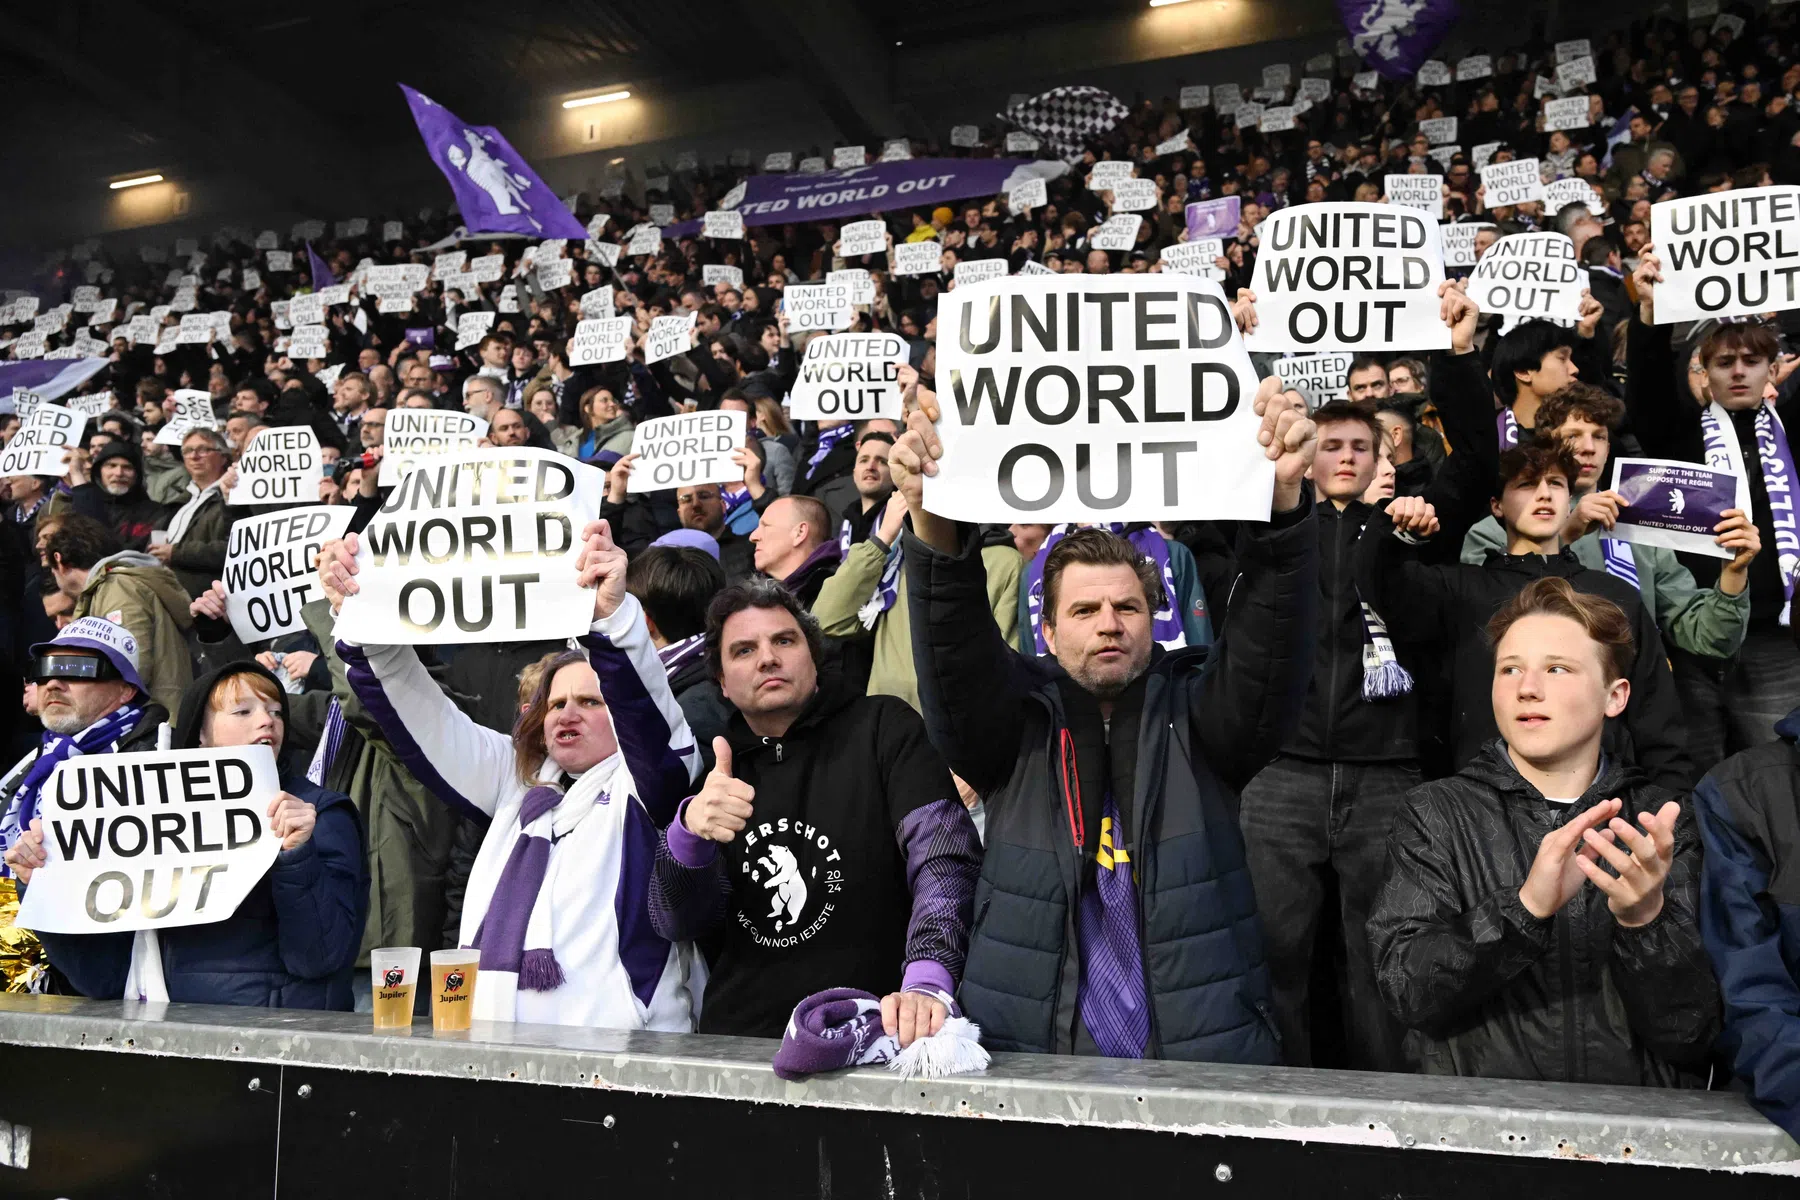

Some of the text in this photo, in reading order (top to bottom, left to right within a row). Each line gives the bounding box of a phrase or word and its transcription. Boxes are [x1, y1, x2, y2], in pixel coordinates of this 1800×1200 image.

[1550, 107, 1586, 118] WORLD
[1554, 117, 1579, 128] OUT
[1486, 162, 1534, 179] UNITED
[1391, 178, 1437, 188] UNITED
[1486, 173, 1537, 190] WORLD
[1549, 181, 1589, 191] UNITE
[738, 199, 790, 216] TED
[797, 184, 889, 210] WORLD
[896, 174, 955, 194] OUT
[1116, 189, 1155, 198] WORLD
[1391, 190, 1437, 201] WORLD
[1497, 187, 1531, 203] OUT
[1122, 200, 1148, 209] OUT
[1671, 193, 1800, 235] UNITE
[844, 223, 880, 234] UNITED
[1271, 212, 1427, 252] UNITED
[1446, 227, 1476, 237] UNIT
[843, 232, 881, 243] WORLD
[1101, 237, 1126, 247] OUT
[850, 242, 875, 253] OUT
[899, 244, 938, 253] UNITED
[1167, 242, 1216, 258] UNITED
[1486, 238, 1575, 260] UNITED
[1667, 229, 1800, 271] WORL
[899, 252, 938, 261] WORLD
[1168, 254, 1216, 269] WORLD
[1454, 251, 1476, 263] OU
[904, 262, 931, 272] OUT
[958, 262, 1002, 274] UNITED
[1264, 255, 1431, 293] WORLD
[1478, 260, 1578, 283] WORLD
[543, 278, 563, 287] OUT
[831, 272, 871, 281] UNITED
[791, 286, 846, 298] UNITED
[1695, 266, 1800, 311] OUT
[325, 293, 341, 302] OUT
[790, 298, 846, 312] WORLD
[1487, 286, 1560, 312] OUT
[296, 313, 315, 323] OUT
[799, 312, 838, 327] OUT
[959, 291, 1233, 355] UNITED
[1288, 301, 1406, 344] OUT
[578, 320, 624, 334] UNITED
[461, 332, 480, 345] OUT
[576, 332, 624, 346] WORLD
[582, 347, 614, 361] OUT
[655, 338, 679, 357] OUT
[809, 339, 901, 360] UNITED
[804, 361, 899, 383] WORLD
[1279, 358, 1346, 377] UNITED
[1285, 375, 1347, 391] ORLD
[818, 389, 886, 414] OUT
[949, 362, 1240, 425] WORLD
[79, 403, 102, 414] OUT
[32, 410, 72, 429] TED
[391, 415, 475, 434] UNITED
[644, 415, 733, 440] UNITED
[9, 430, 68, 449] ORLD
[245, 431, 311, 453] UNITED
[388, 436, 472, 455] WORLD
[640, 435, 733, 460] WORLD
[3, 451, 48, 472] OUT
[240, 453, 312, 474] WORLD
[653, 458, 717, 484] OUT
[997, 441, 1197, 512] OUT
[1648, 467, 1713, 480] SUPPORT THE TEAM
[251, 476, 302, 499] OUT
[380, 459, 575, 514] UNITED
[1646, 476, 1674, 484] OPPOSE
[1689, 480, 1714, 488] REGIME
[1638, 519, 1708, 533] UNITED WORLD OUT
[228, 512, 331, 559] UNITED
[366, 512, 572, 568] WORLD
[225, 542, 321, 594] WORLD
[247, 584, 312, 633] OUT
[398, 572, 540, 633] OUT
[80, 618, 114, 635] PORTER
[63, 626, 117, 645] ERSCHOT
[56, 758, 252, 811] UNITED
[52, 808, 262, 861] WORLD
[826, 869, 842, 880] 20
[84, 864, 229, 923] OUT
[827, 883, 842, 894] 24
[736, 909, 752, 929] WE
[799, 902, 835, 941] IEJESTE
[378, 991, 408, 1000] Jupiler
[439, 994, 468, 1004] Jupiler
